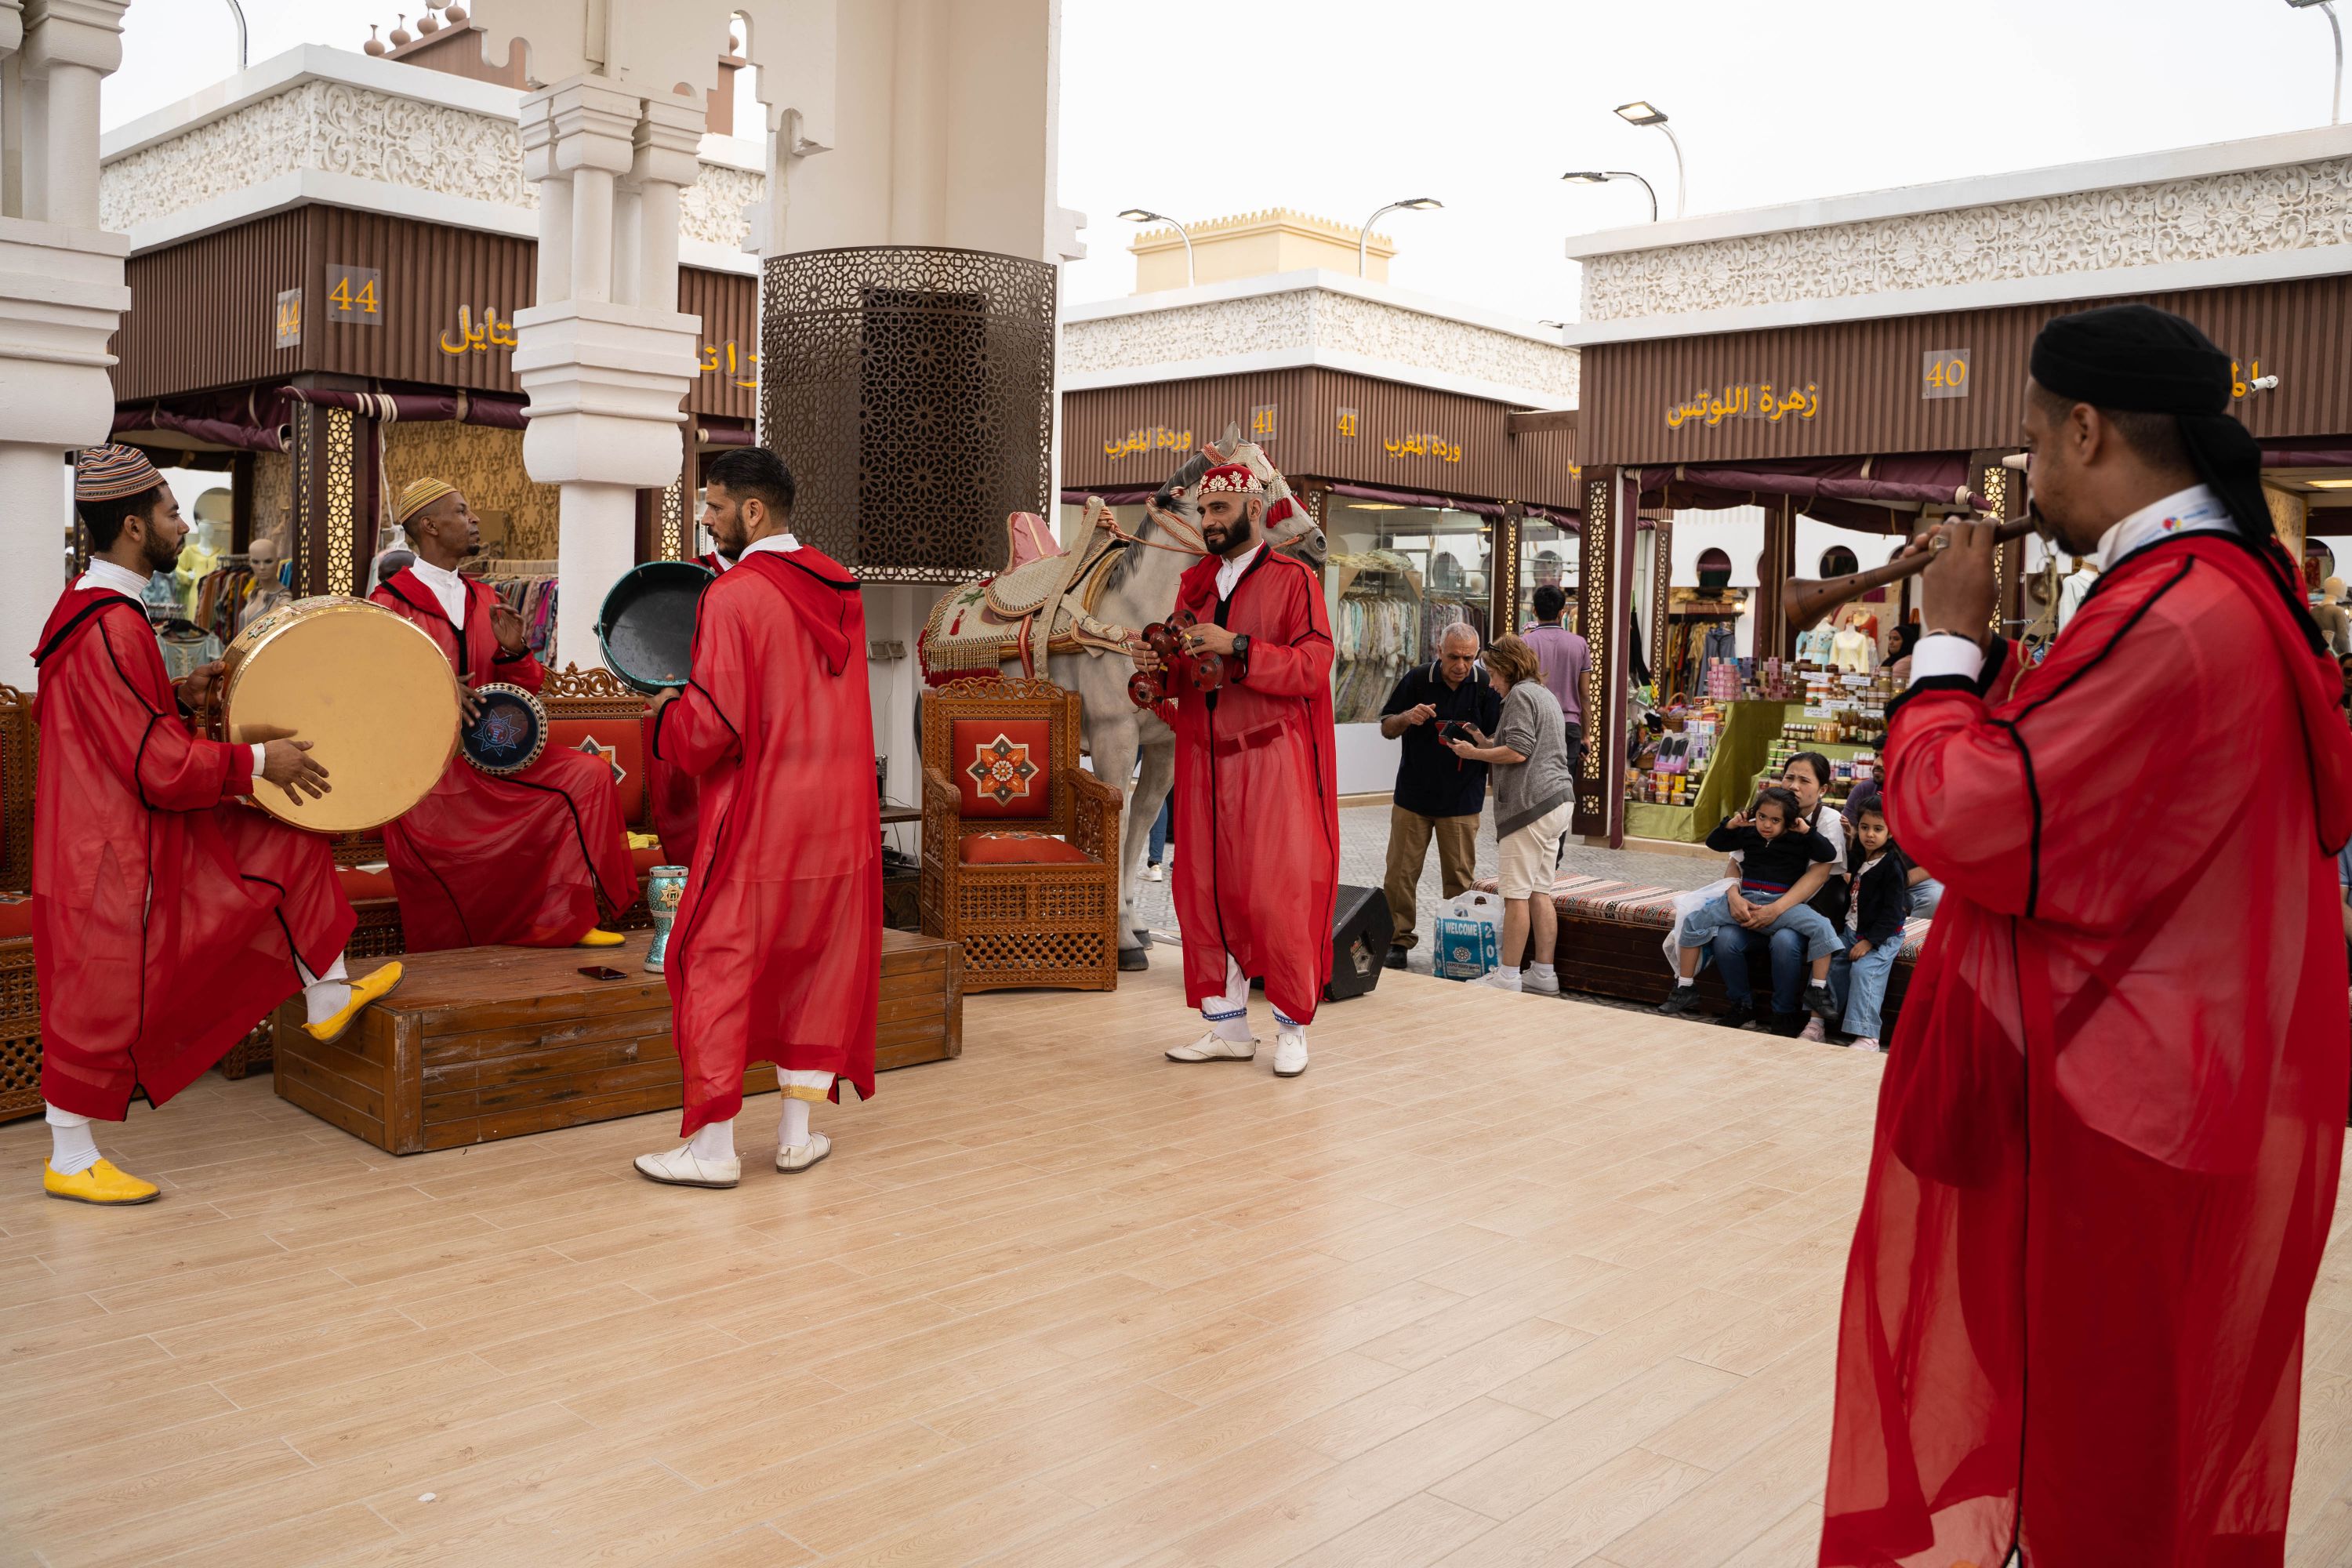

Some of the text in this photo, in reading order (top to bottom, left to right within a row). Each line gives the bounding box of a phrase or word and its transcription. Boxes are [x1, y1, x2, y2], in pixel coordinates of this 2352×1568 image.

[328, 276, 379, 314] 44
[278, 299, 299, 337] 44
[1925, 359, 1966, 388] 40
[1254, 408, 1275, 434] 41
[1667, 383, 1818, 427] زهرة اللوتس
[1337, 413, 1356, 437] 41
[1103, 426, 1192, 461] وردة المغرب
[1383, 432, 1462, 464] وردة المغرب
[1445, 921, 1478, 936] WELCOME
